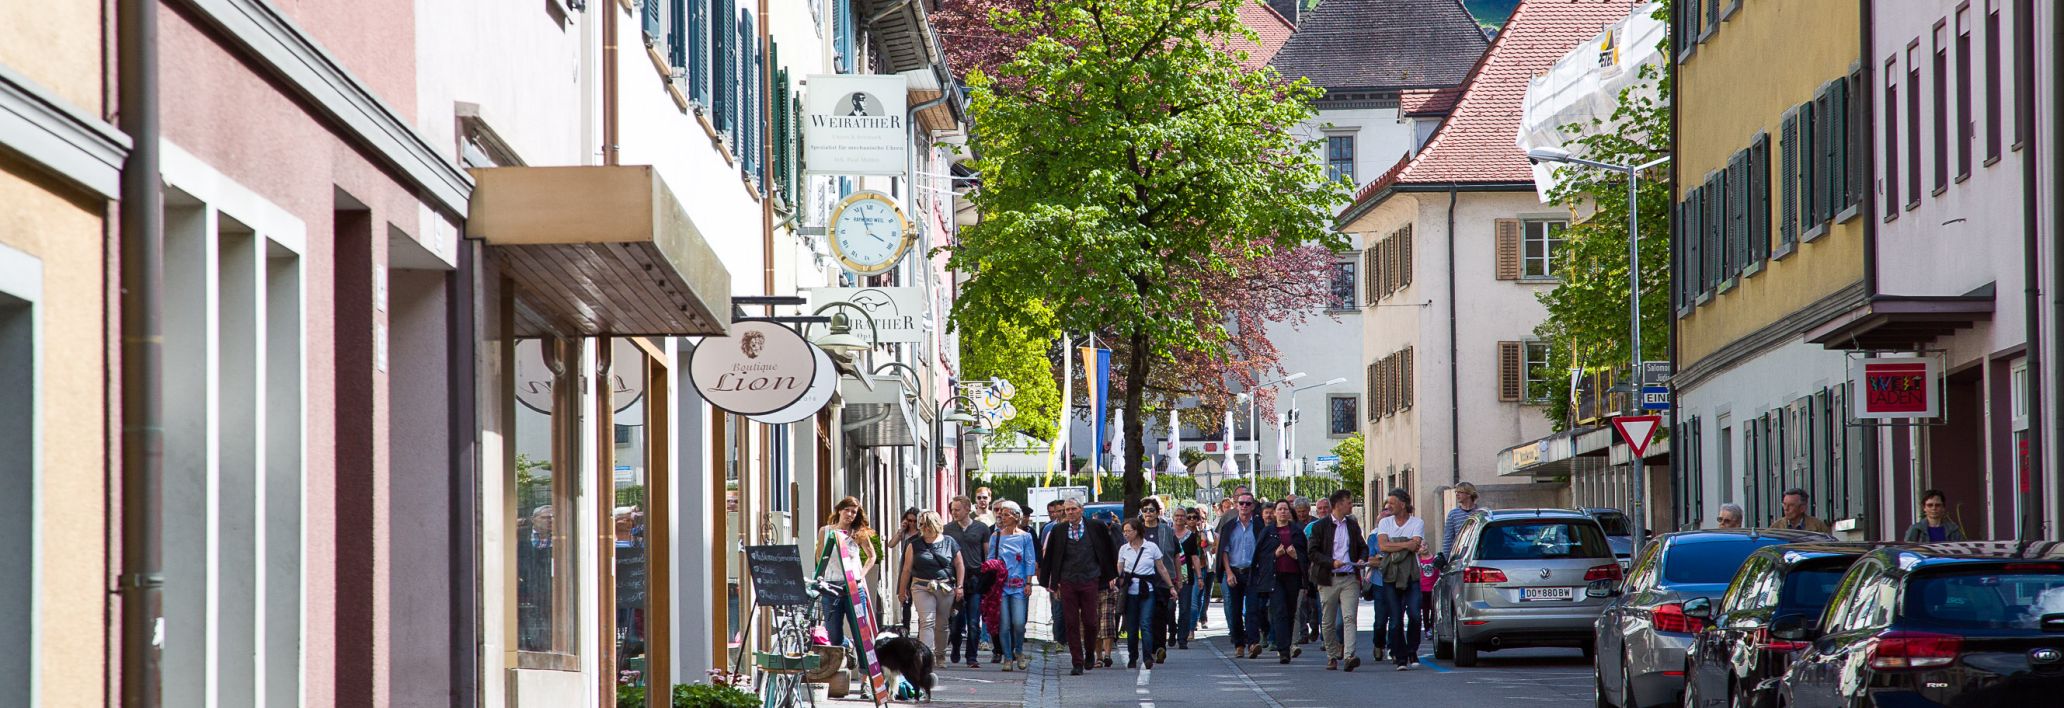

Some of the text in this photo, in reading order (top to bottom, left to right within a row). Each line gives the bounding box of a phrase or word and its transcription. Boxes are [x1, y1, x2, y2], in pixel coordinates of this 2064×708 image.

[811, 114, 901, 129] WEIRATHER
[732, 361, 779, 373] Boutique
[707, 371, 804, 393] Lion
[1869, 375, 1922, 391] WELT
[1869, 391, 1923, 404] LADEN
